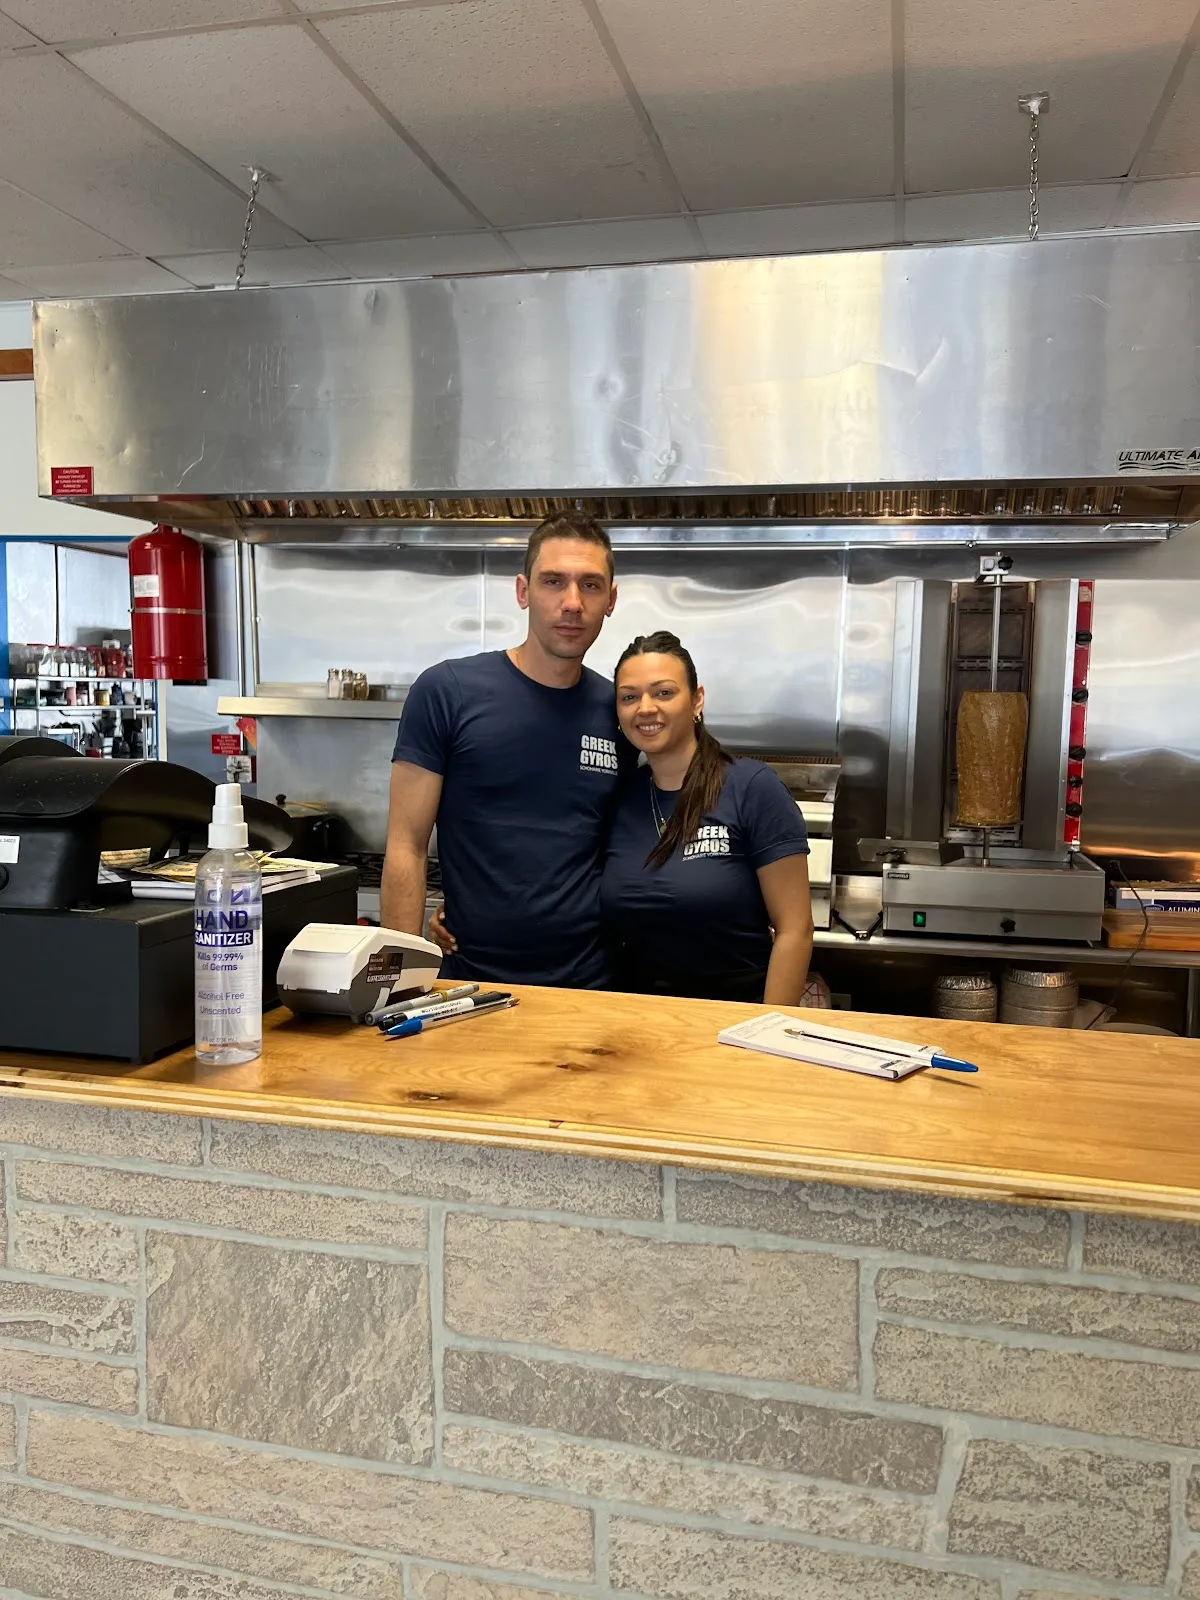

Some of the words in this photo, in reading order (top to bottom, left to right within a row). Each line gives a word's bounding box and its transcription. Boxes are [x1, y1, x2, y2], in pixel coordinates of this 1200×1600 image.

[1118, 450, 1184, 461] ULTIMATE
[581, 734, 617, 755] GREEK
[580, 749, 618, 770] GYROS
[690, 825, 730, 840] REEK
[684, 838, 730, 856] GYROS
[196, 909, 248, 930] HAND
[194, 931, 252, 946] SANITIZER
[197, 951, 211, 961] Kills
[212, 952, 244, 961] 99.99%
[210, 963, 238, 971] Germs
[197, 991, 224, 1001] Alcohol
[225, 992, 245, 1001] Free
[200, 1005, 242, 1015] Unscented
